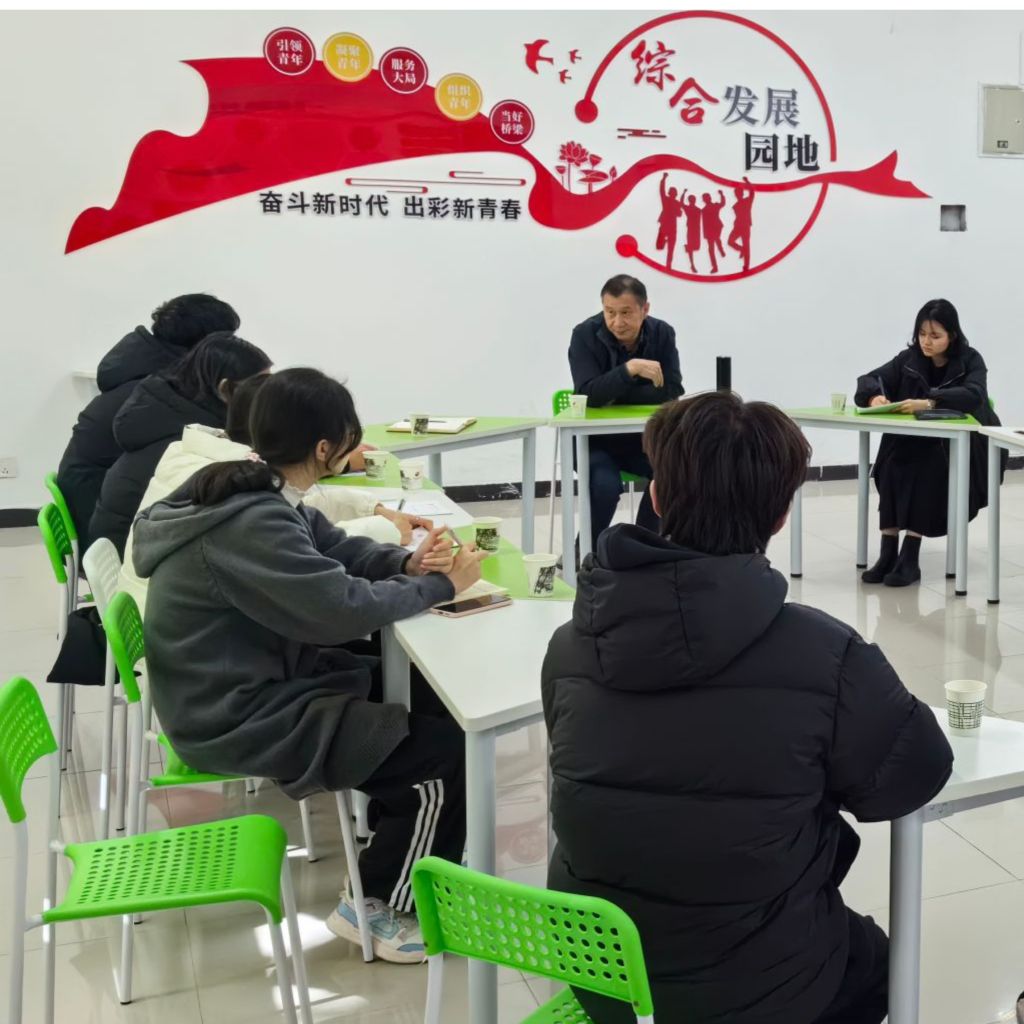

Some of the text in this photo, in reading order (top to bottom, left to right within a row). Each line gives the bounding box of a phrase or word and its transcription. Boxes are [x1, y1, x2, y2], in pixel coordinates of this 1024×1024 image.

[276, 39, 303, 52] 引领
[279, 52, 303, 66] 青年
[391, 58, 415, 71] 服务
[393, 72, 416, 85] 大局
[501, 110, 523, 123] 当好
[501, 123, 524, 135] 桥梁
[744, 132, 820, 172] 园地
[259, 191, 522, 221] 奋斗新时代 出彩新青春
